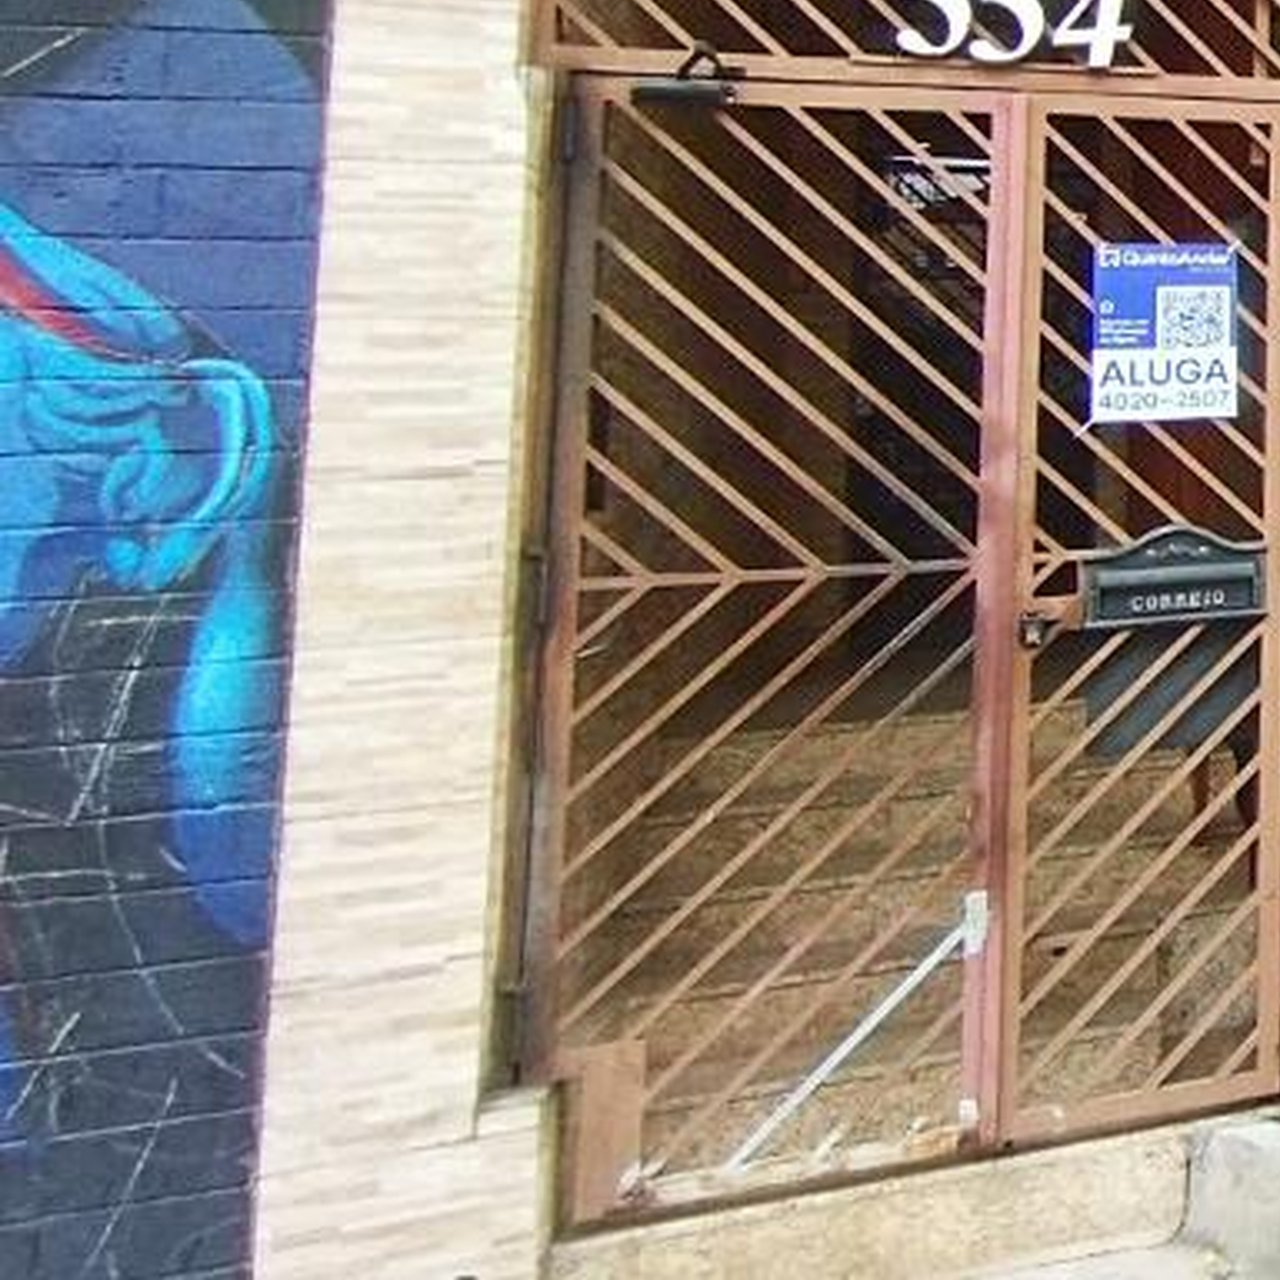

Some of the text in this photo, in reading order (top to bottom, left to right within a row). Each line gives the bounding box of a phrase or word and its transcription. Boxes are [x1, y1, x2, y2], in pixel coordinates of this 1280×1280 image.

[1100, 357, 1228, 388] ALUGA
[1100, 389, 1230, 411] 4020-2507
[1131, 588, 1226, 612] CORREIO
